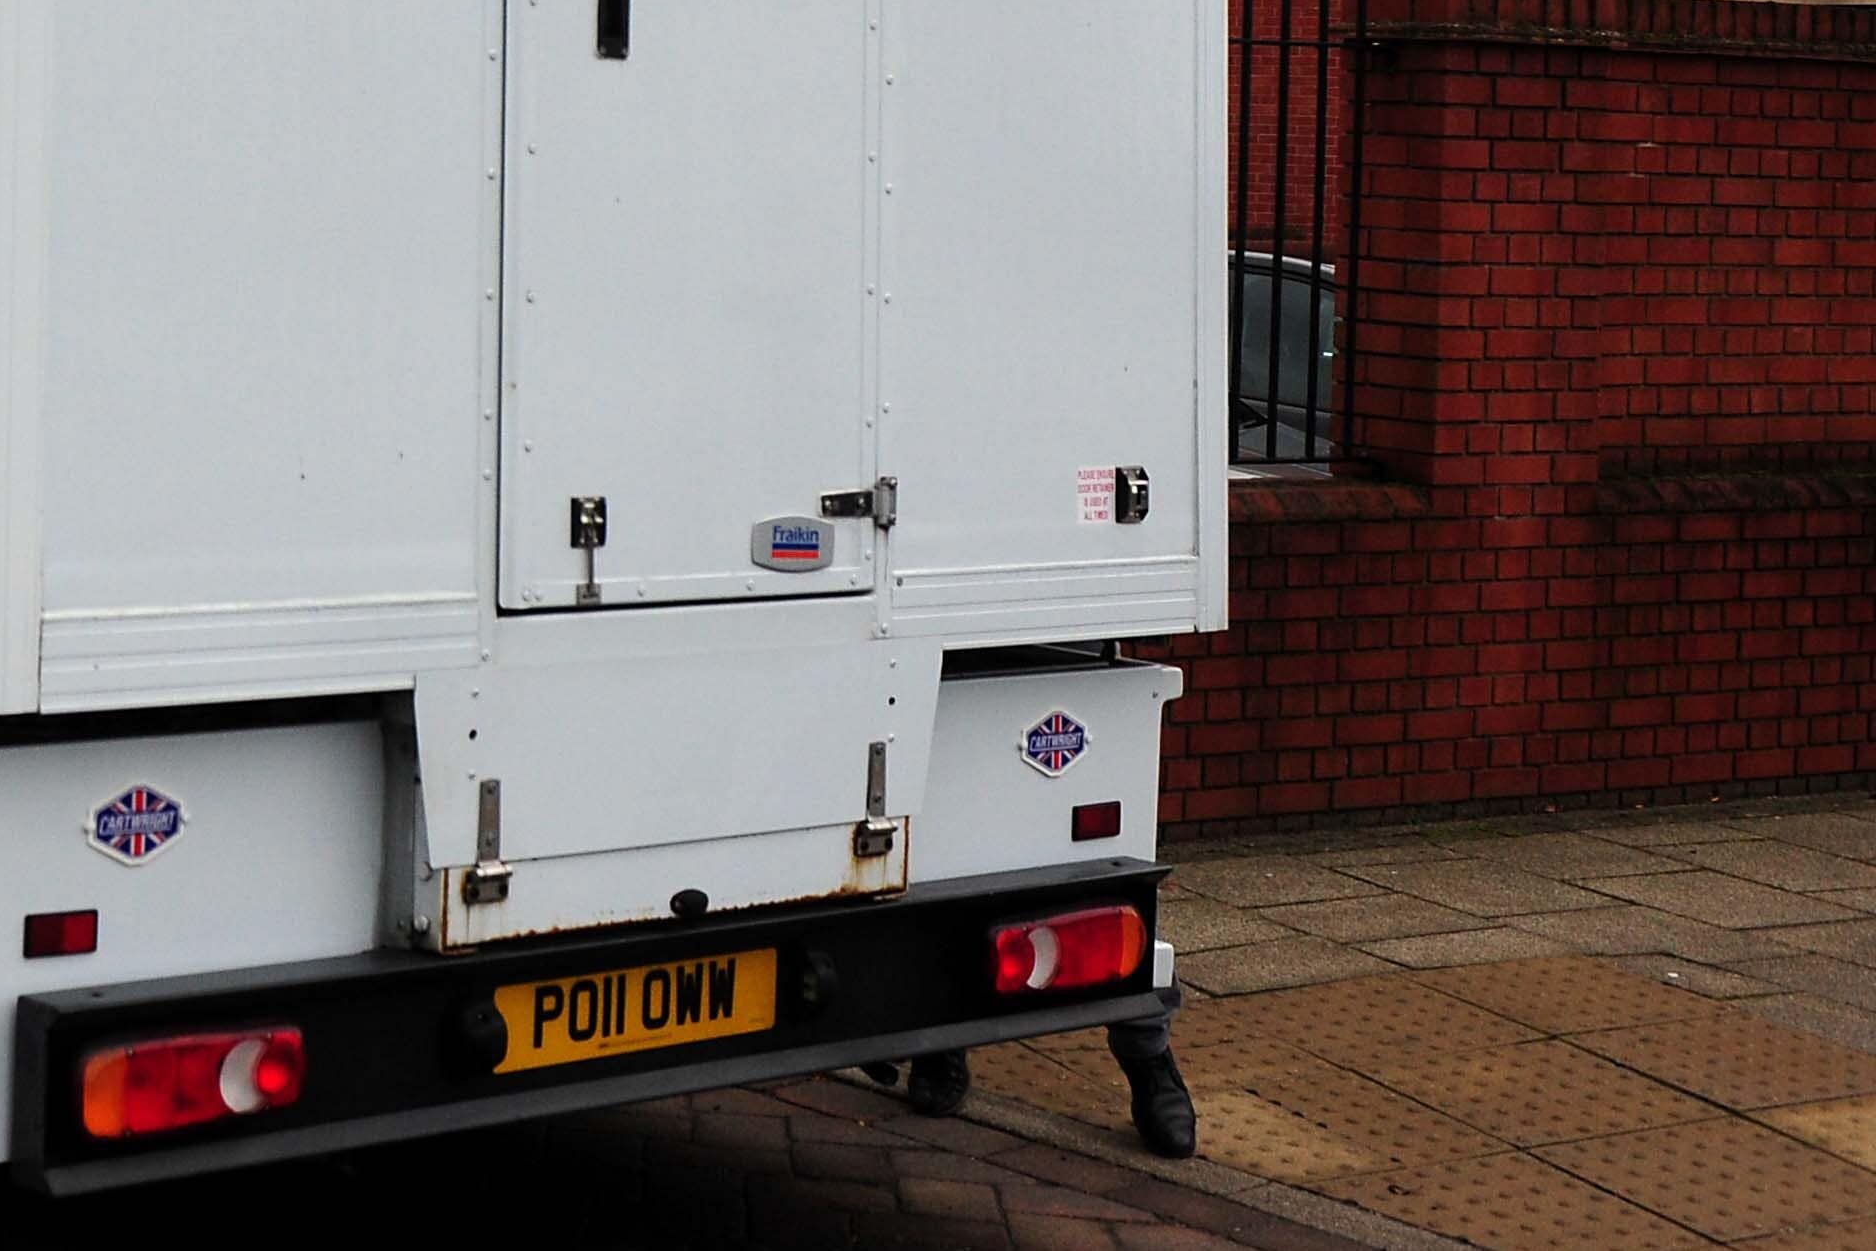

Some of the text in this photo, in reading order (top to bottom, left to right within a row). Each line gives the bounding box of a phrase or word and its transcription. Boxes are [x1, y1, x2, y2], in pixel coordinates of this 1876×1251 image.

[772, 525, 820, 543] Fraikin
[1029, 732, 1082, 753] CARTWRIGHT
[99, 810, 176, 836] CARTWRIGHT
[532, 957, 737, 1049] PO11 OWW
